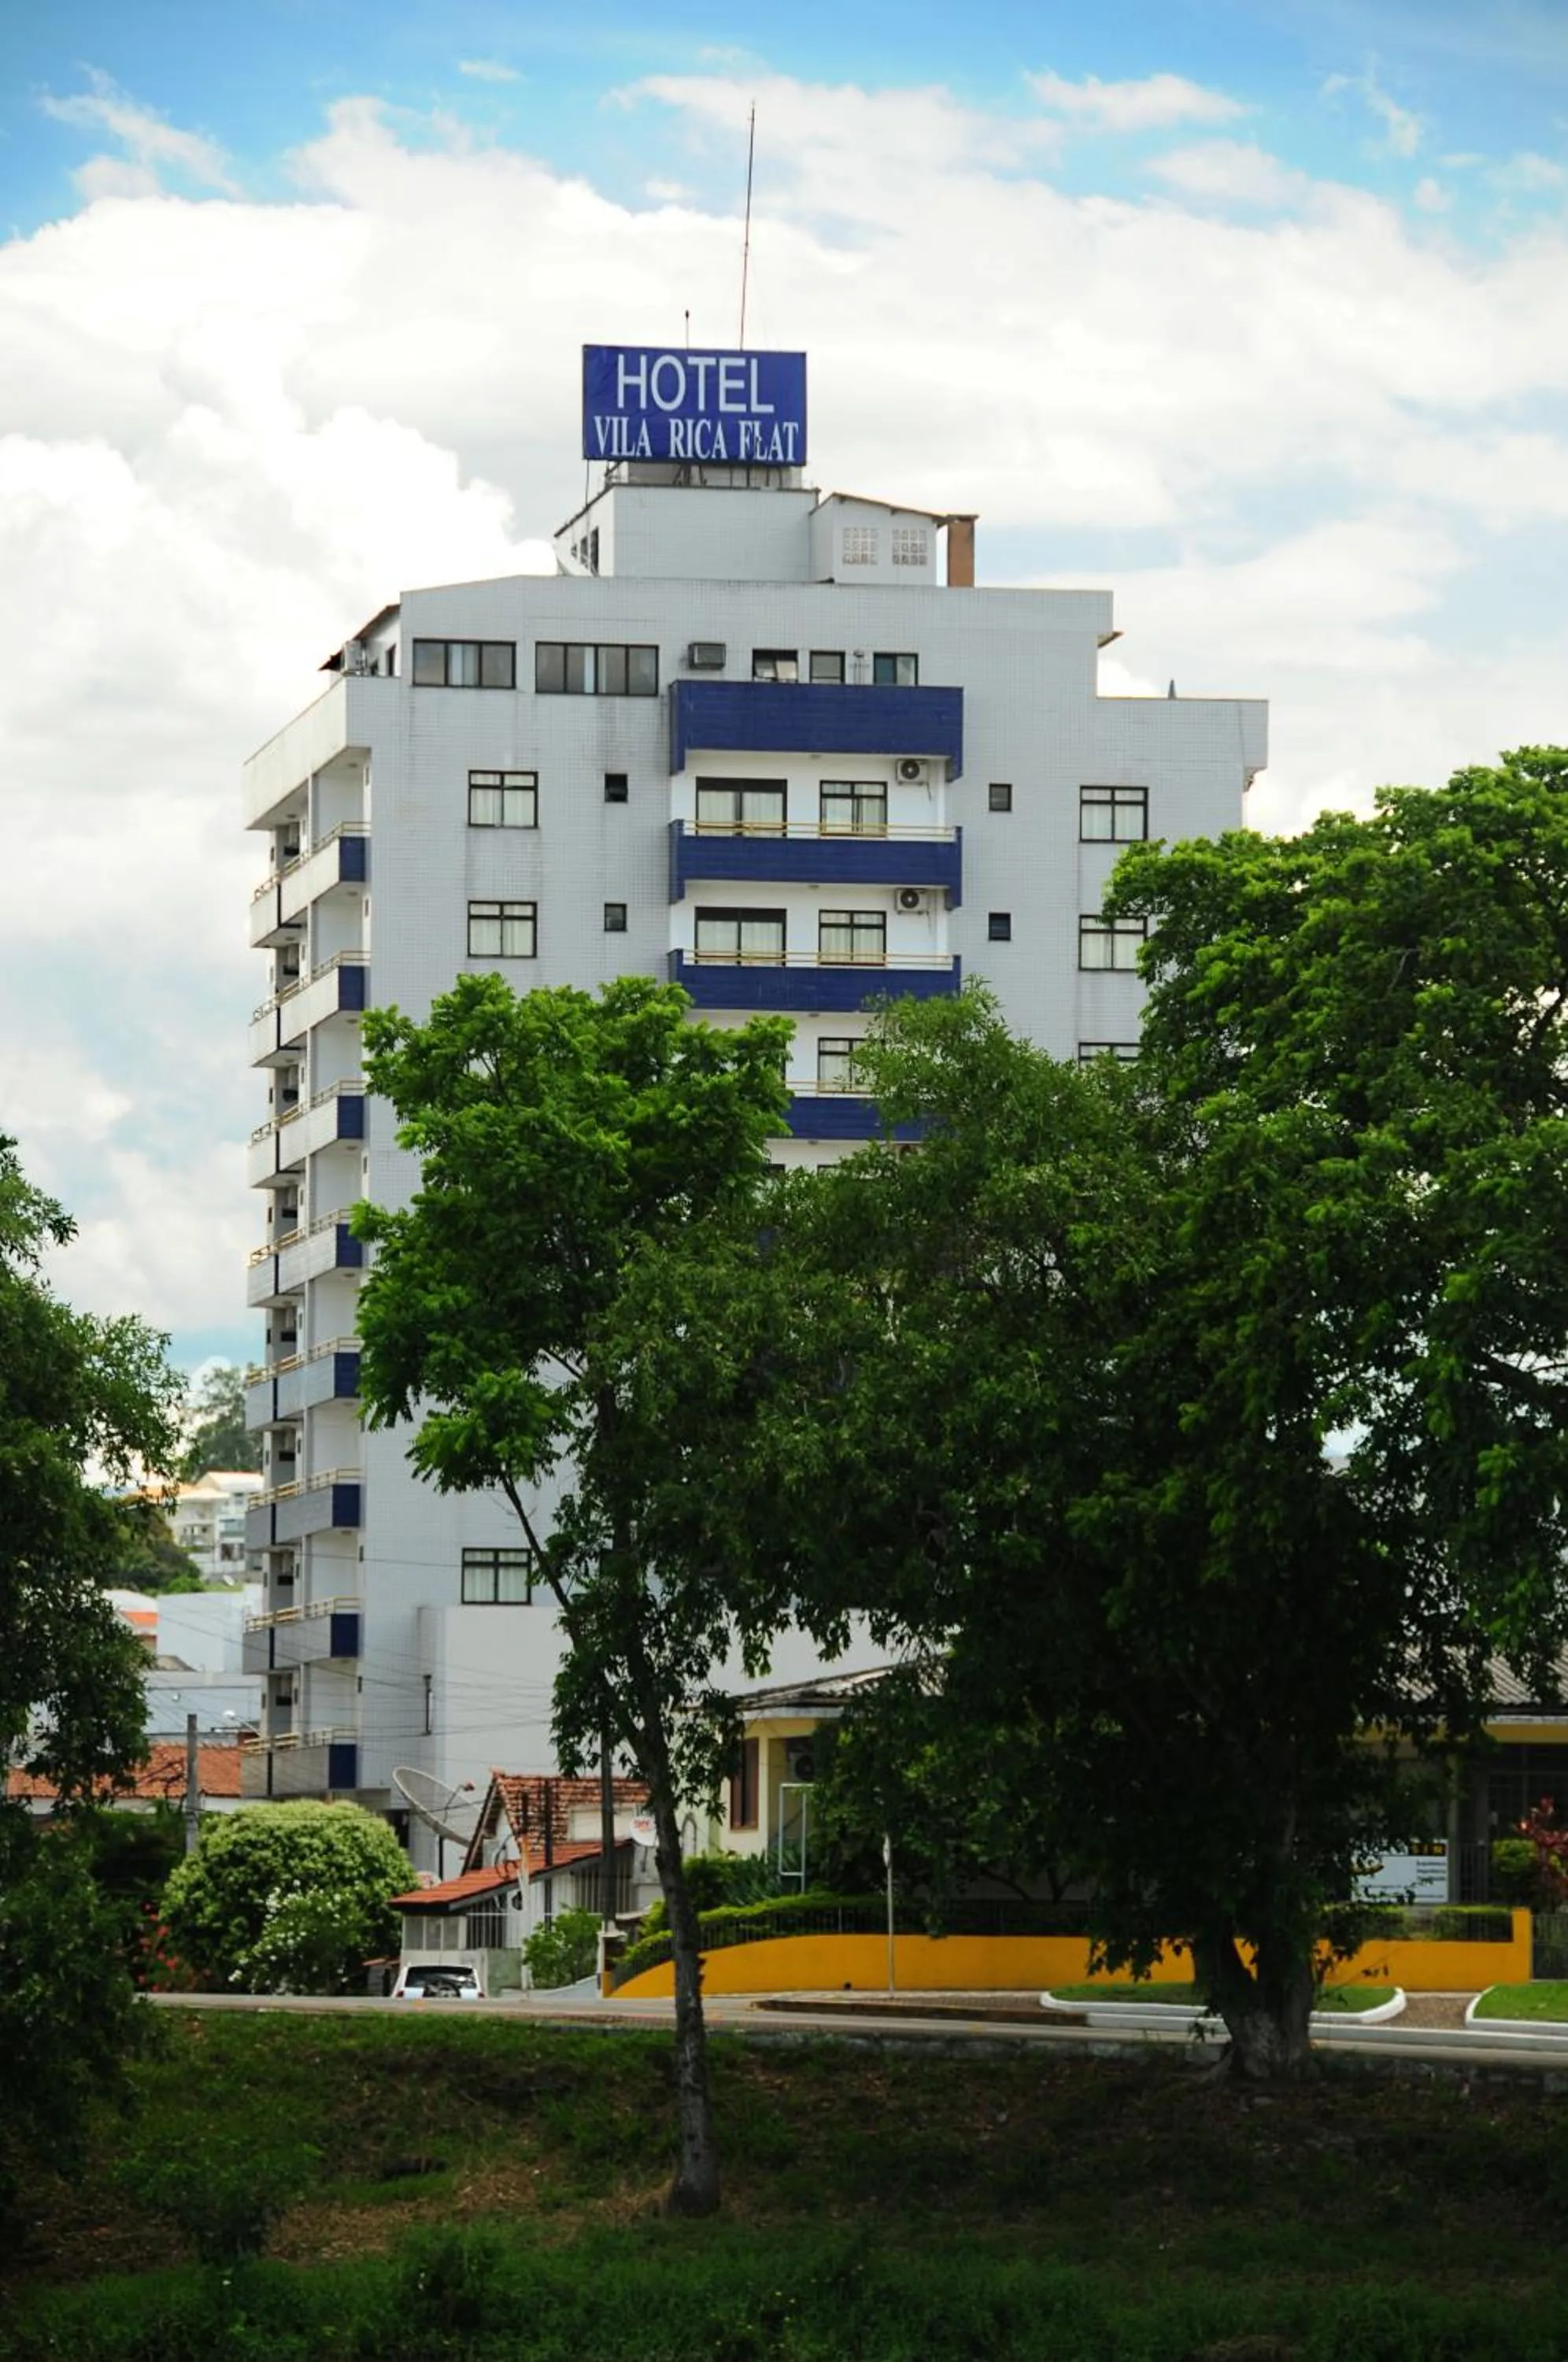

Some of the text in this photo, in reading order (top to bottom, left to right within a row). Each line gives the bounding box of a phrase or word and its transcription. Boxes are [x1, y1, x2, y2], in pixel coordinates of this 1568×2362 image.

[617, 354, 775, 413] HOTEL
[594, 416, 799, 461] VILA RICA FLAT
